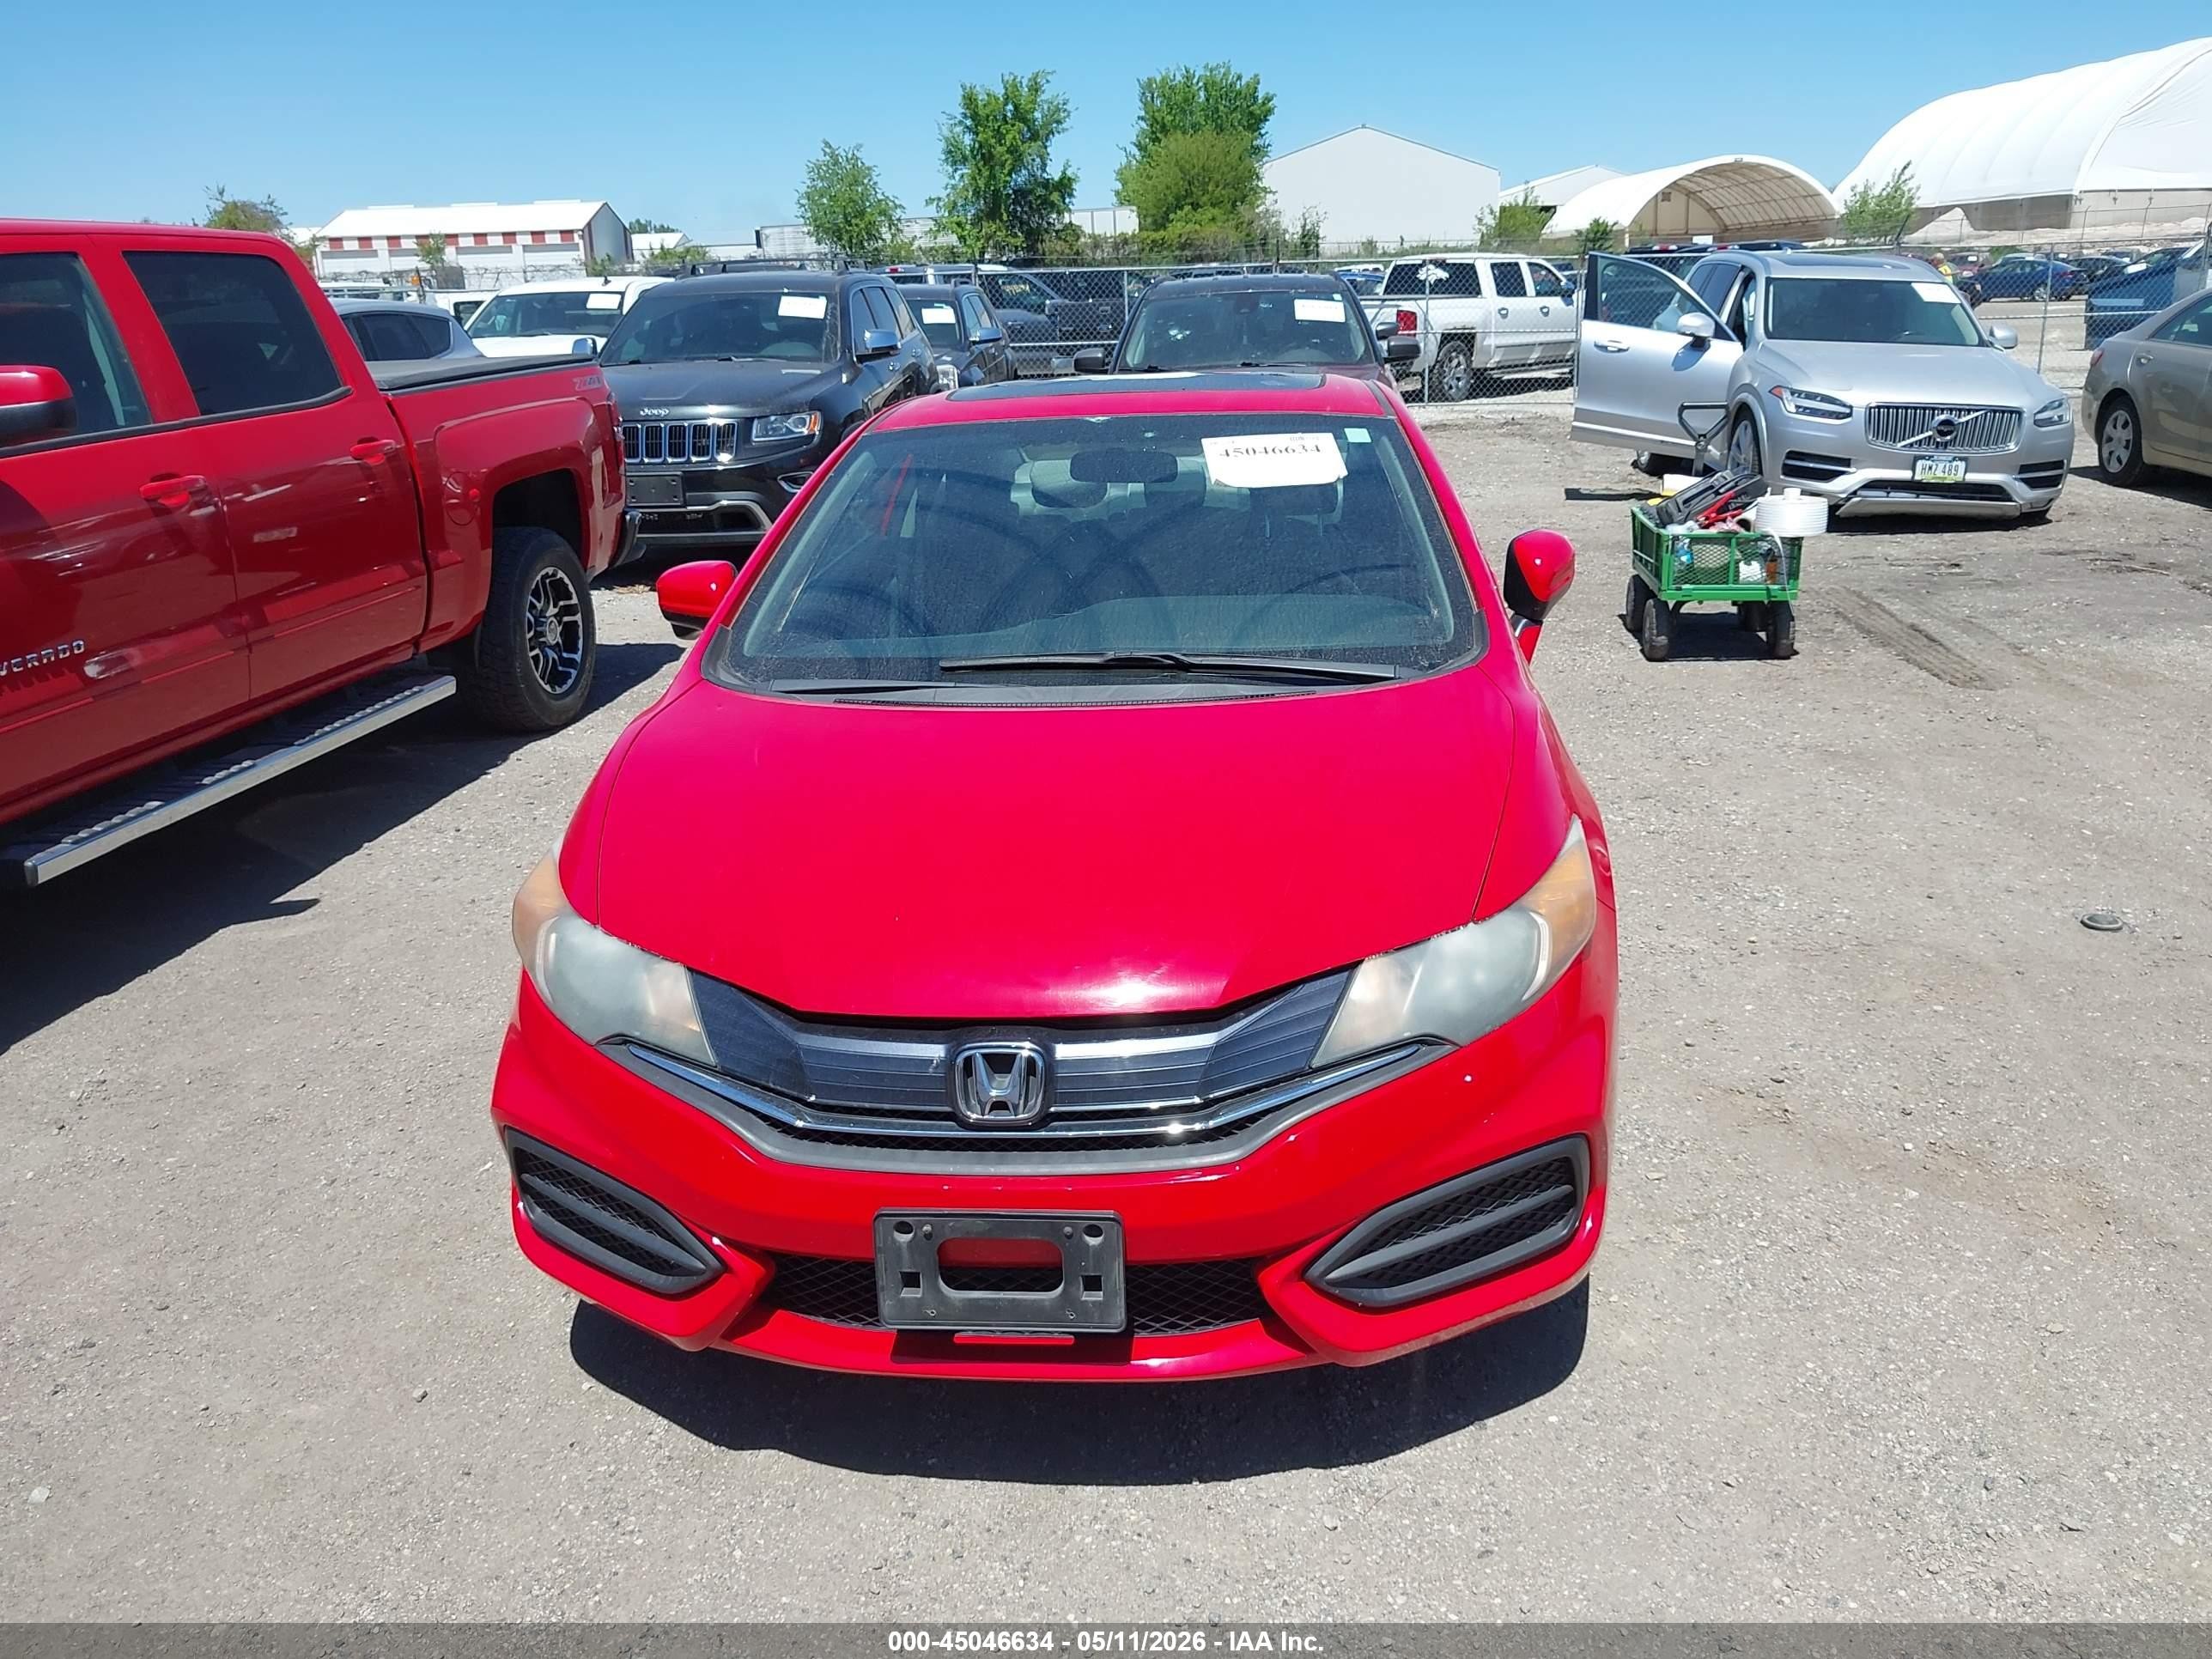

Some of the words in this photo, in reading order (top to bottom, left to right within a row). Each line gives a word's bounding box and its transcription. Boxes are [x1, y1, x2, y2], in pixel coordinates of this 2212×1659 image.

[640, 408, 670, 417] Jeep
[1219, 444, 1321, 458] 45046634
[1942, 464, 1960, 477] 489
